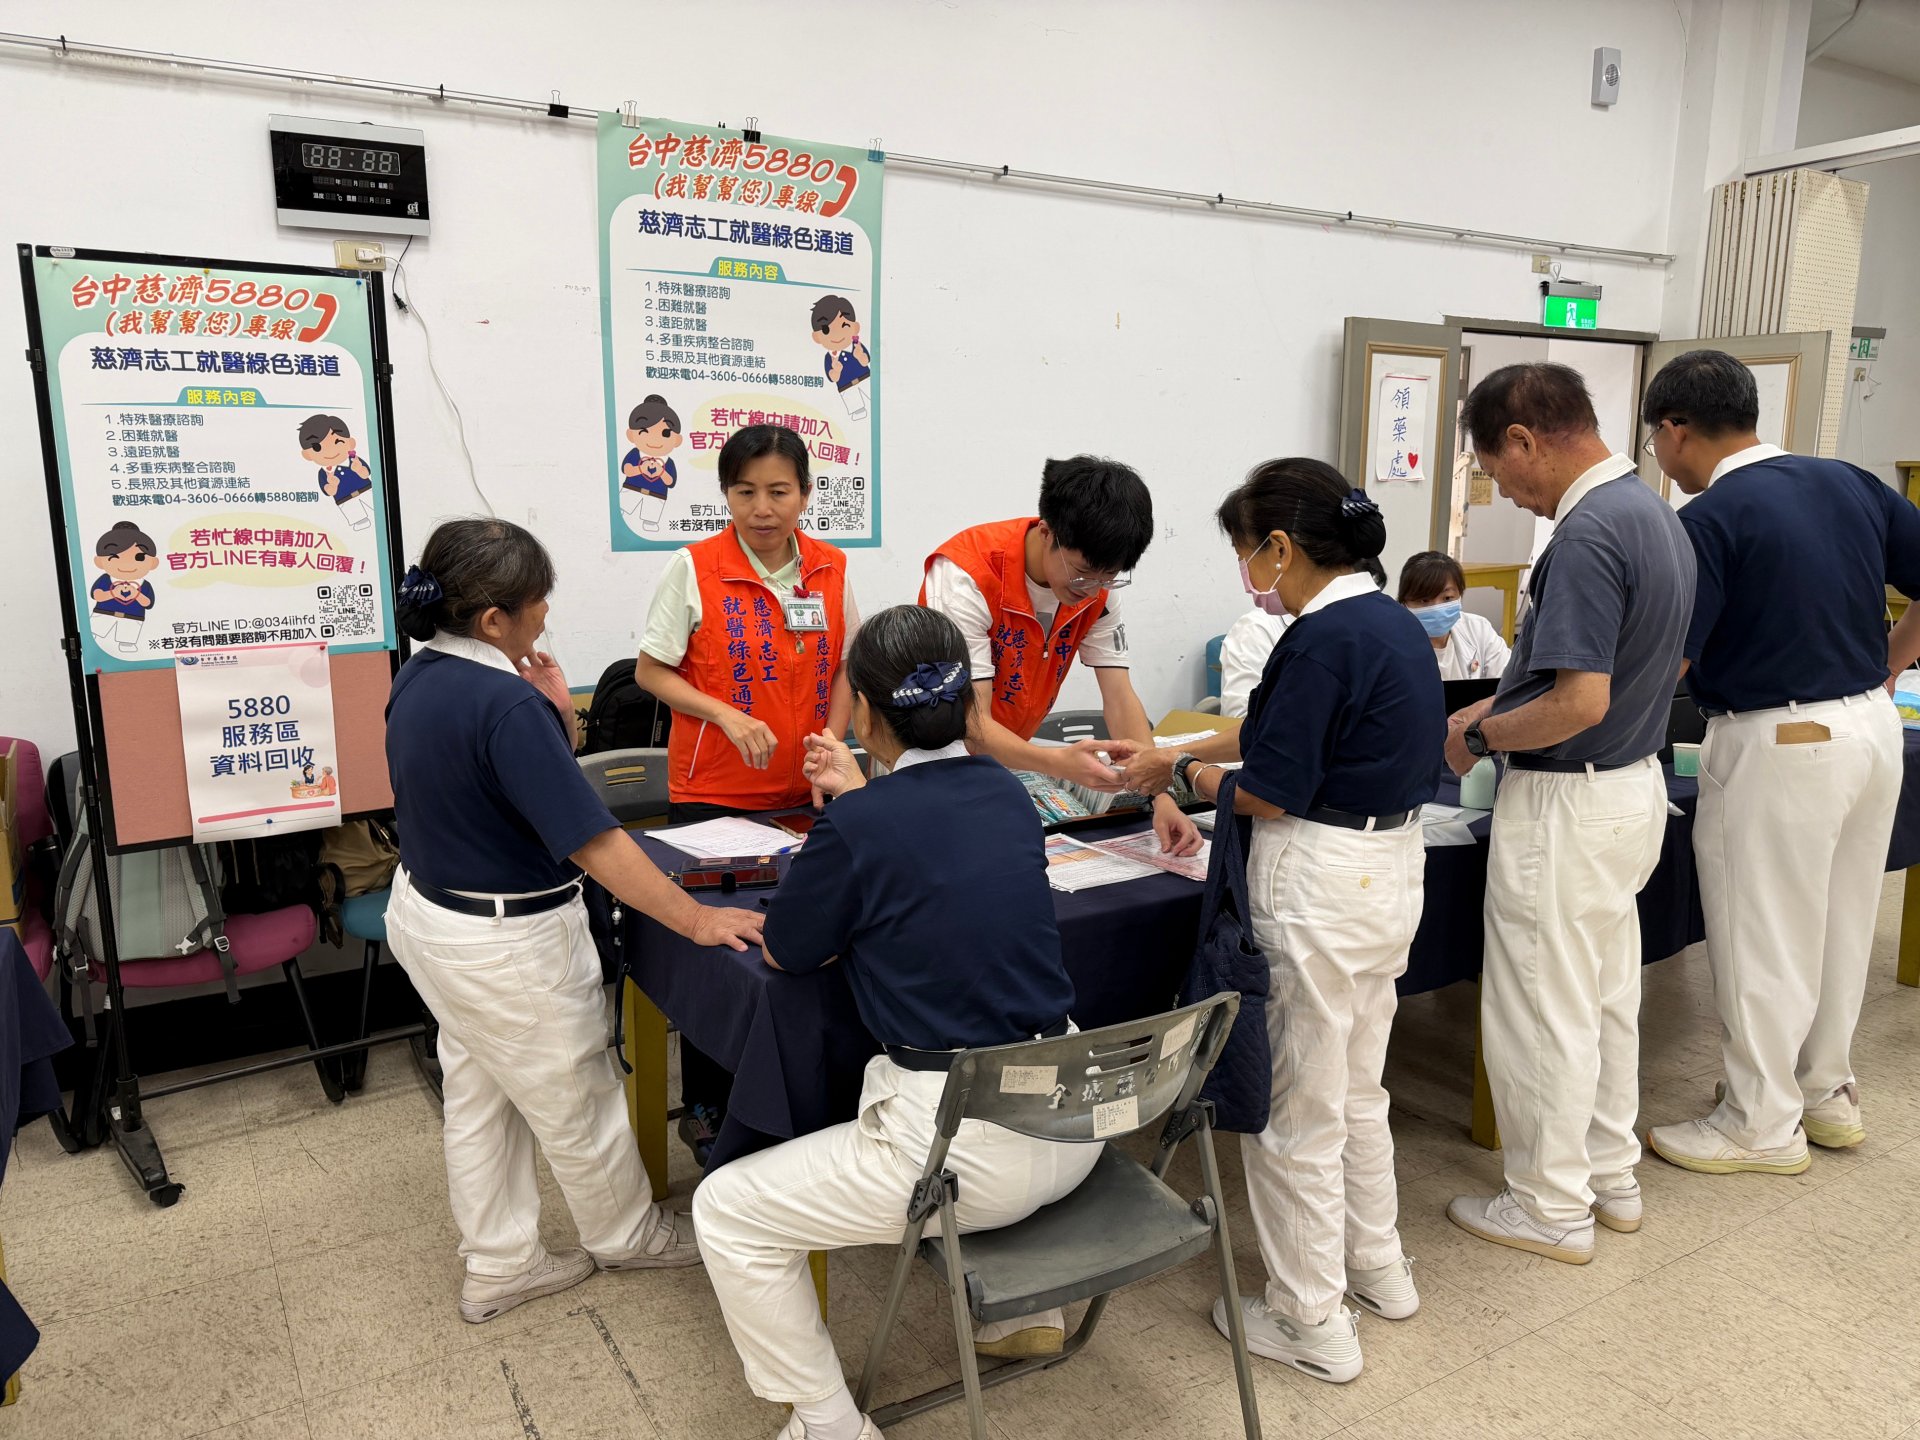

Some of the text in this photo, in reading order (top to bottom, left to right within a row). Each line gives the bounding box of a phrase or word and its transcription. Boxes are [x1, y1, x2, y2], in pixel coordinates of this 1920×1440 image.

[628, 133, 835, 182] 台中慈濟5880
[654, 173, 819, 213] (我幫幫您)專線
[638, 209, 854, 256] 慈濟志工就醫綠色通道
[718, 261, 779, 280] 服務內容
[71, 274, 311, 312] 台中慈濟5880
[645, 281, 731, 300] 1.特殊醫療諮詢
[644, 298, 707, 315] 2.困難就醫
[105, 310, 299, 340] (我幫幫您)專線
[645, 316, 707, 332] 3.遠距就醫
[645, 333, 754, 351] 4.多重疾病整合諮詢
[90, 346, 341, 377] 慈濟志工就醫綠色通道
[645, 350, 766, 369] 5.長照及其他資源連結
[187, 389, 257, 405] 服務內容
[104, 413, 204, 426] 1.特殊醫療諮詢
[105, 429, 178, 442] 2.困難就醫
[108, 445, 180, 458] 3.遠距就醫
[109, 461, 236, 474] 4.多重疾病整合諮詢
[111, 477, 251, 490] 5.長照及其他資源連結
[690, 504, 732, 517] 官方LIN
[833, 500, 849, 508] LINE
[190, 528, 333, 550] 若忙線中請加入
[166, 551, 366, 574] 官方LINE有專人回覆!
[337, 607, 356, 615] LINE
[172, 620, 230, 634] 官方LINE
[753, 596, 778, 682] 慈濟志工
[228, 695, 291, 719] 5880
[222, 720, 300, 748] 服務區
[210, 746, 316, 778] 資料回收
